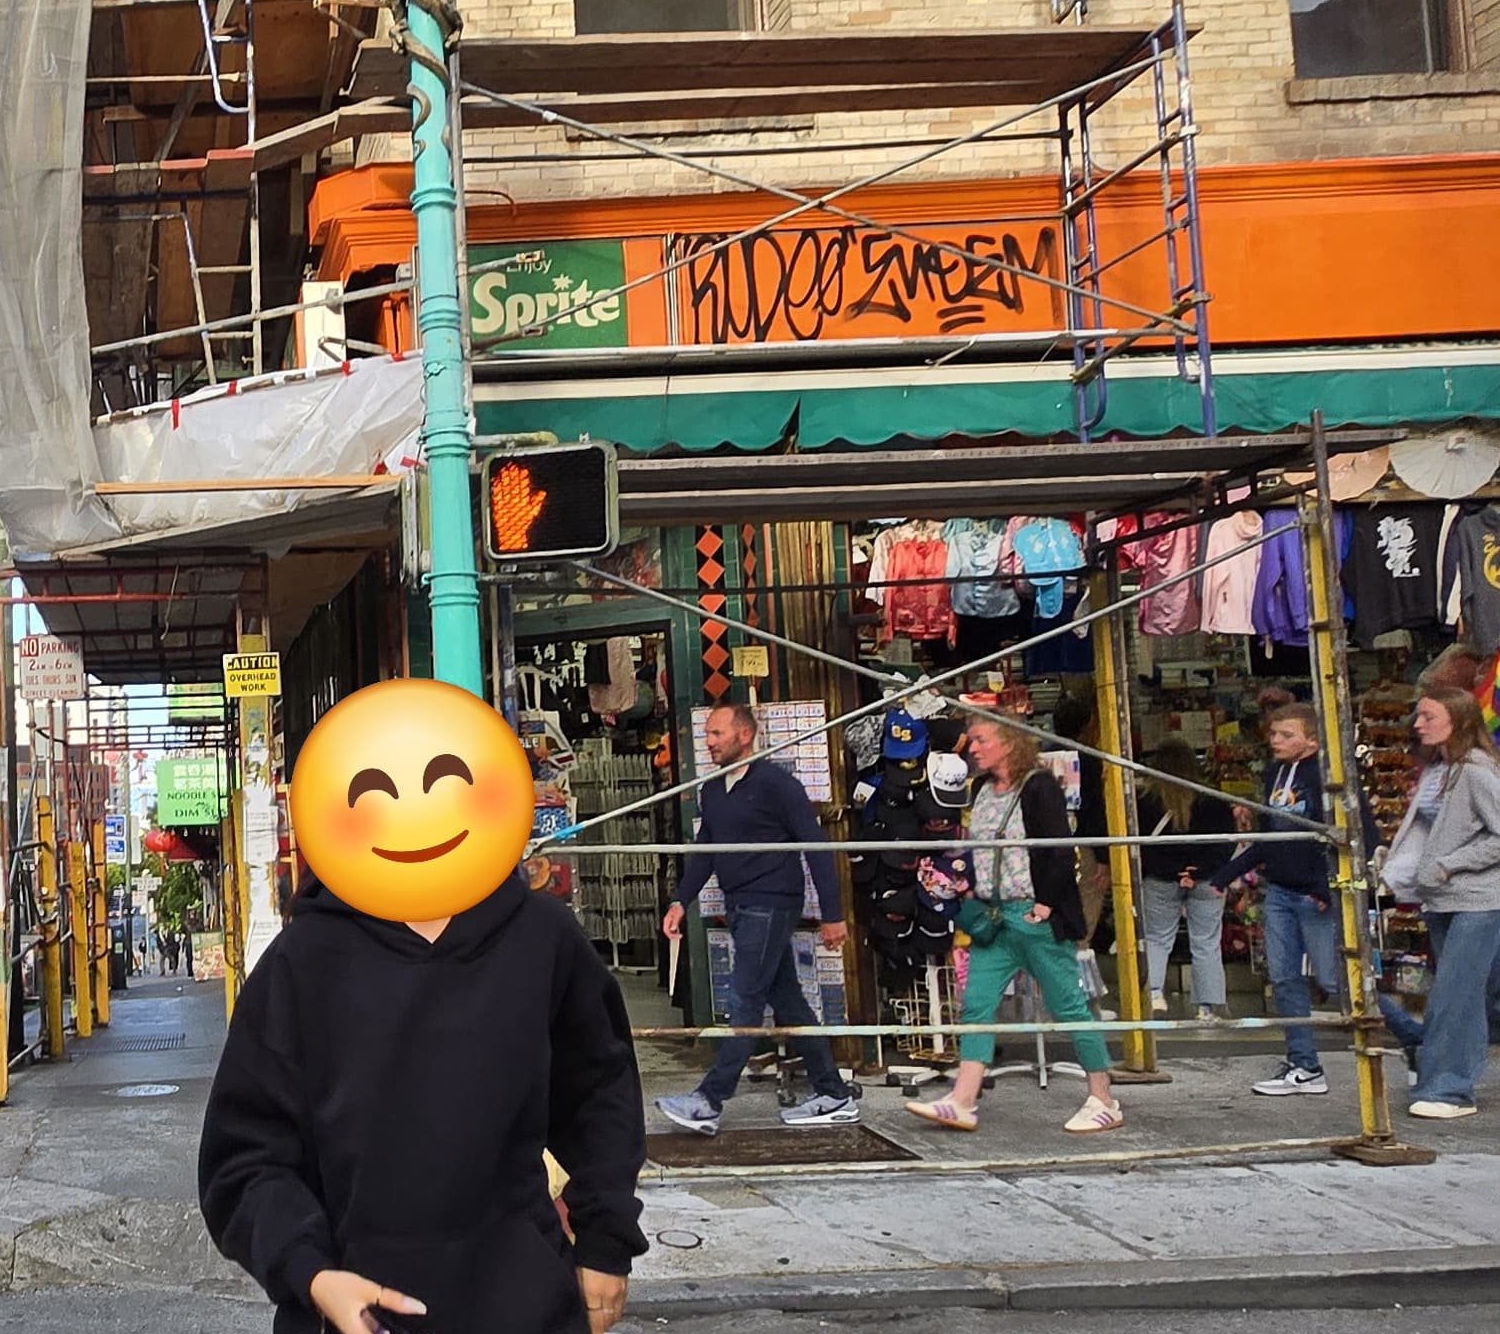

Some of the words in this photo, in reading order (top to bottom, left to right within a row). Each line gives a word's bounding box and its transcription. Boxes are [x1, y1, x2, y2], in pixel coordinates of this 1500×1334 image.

[471, 272, 620, 337] Sprite
[21, 639, 38, 656] NO
[41, 641, 80, 655] PARKING
[230, 672, 276, 682] OVERHEAD
[241, 683, 267, 692] WORK
[175, 809, 199, 818] DIM
